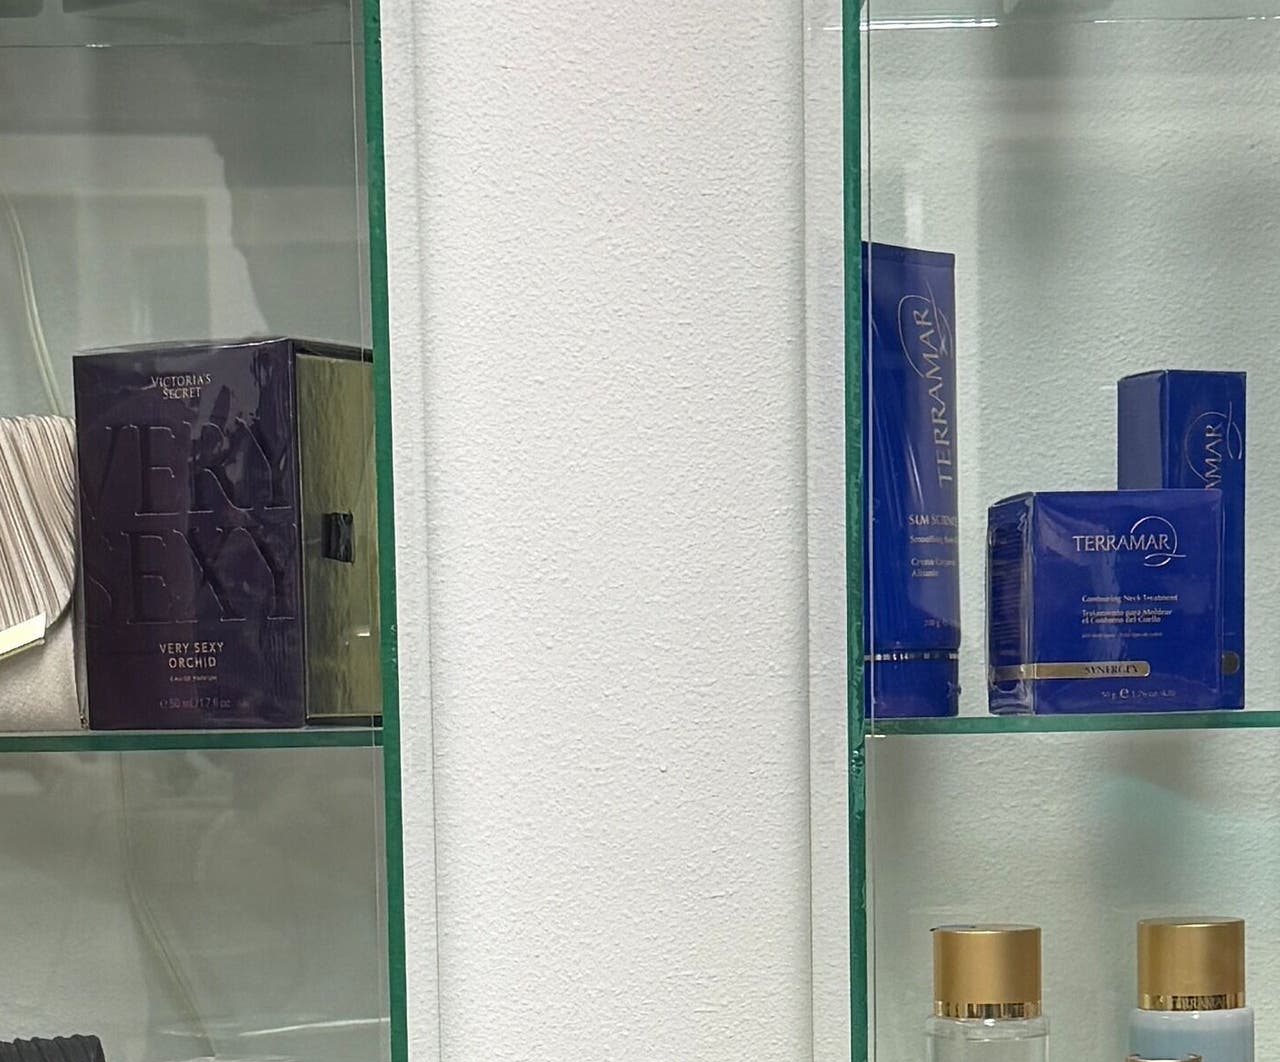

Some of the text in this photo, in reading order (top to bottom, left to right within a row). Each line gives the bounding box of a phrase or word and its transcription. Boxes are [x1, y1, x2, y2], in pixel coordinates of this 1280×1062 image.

[151, 373, 211, 388] VICTORIA'S
[163, 386, 200, 400] SECRET
[913, 308, 953, 488] TERRAMAR
[1072, 532, 1171, 552] TERRAMAR
[160, 642, 224, 654] VERY SEXY
[169, 656, 216, 669] ORCHID
